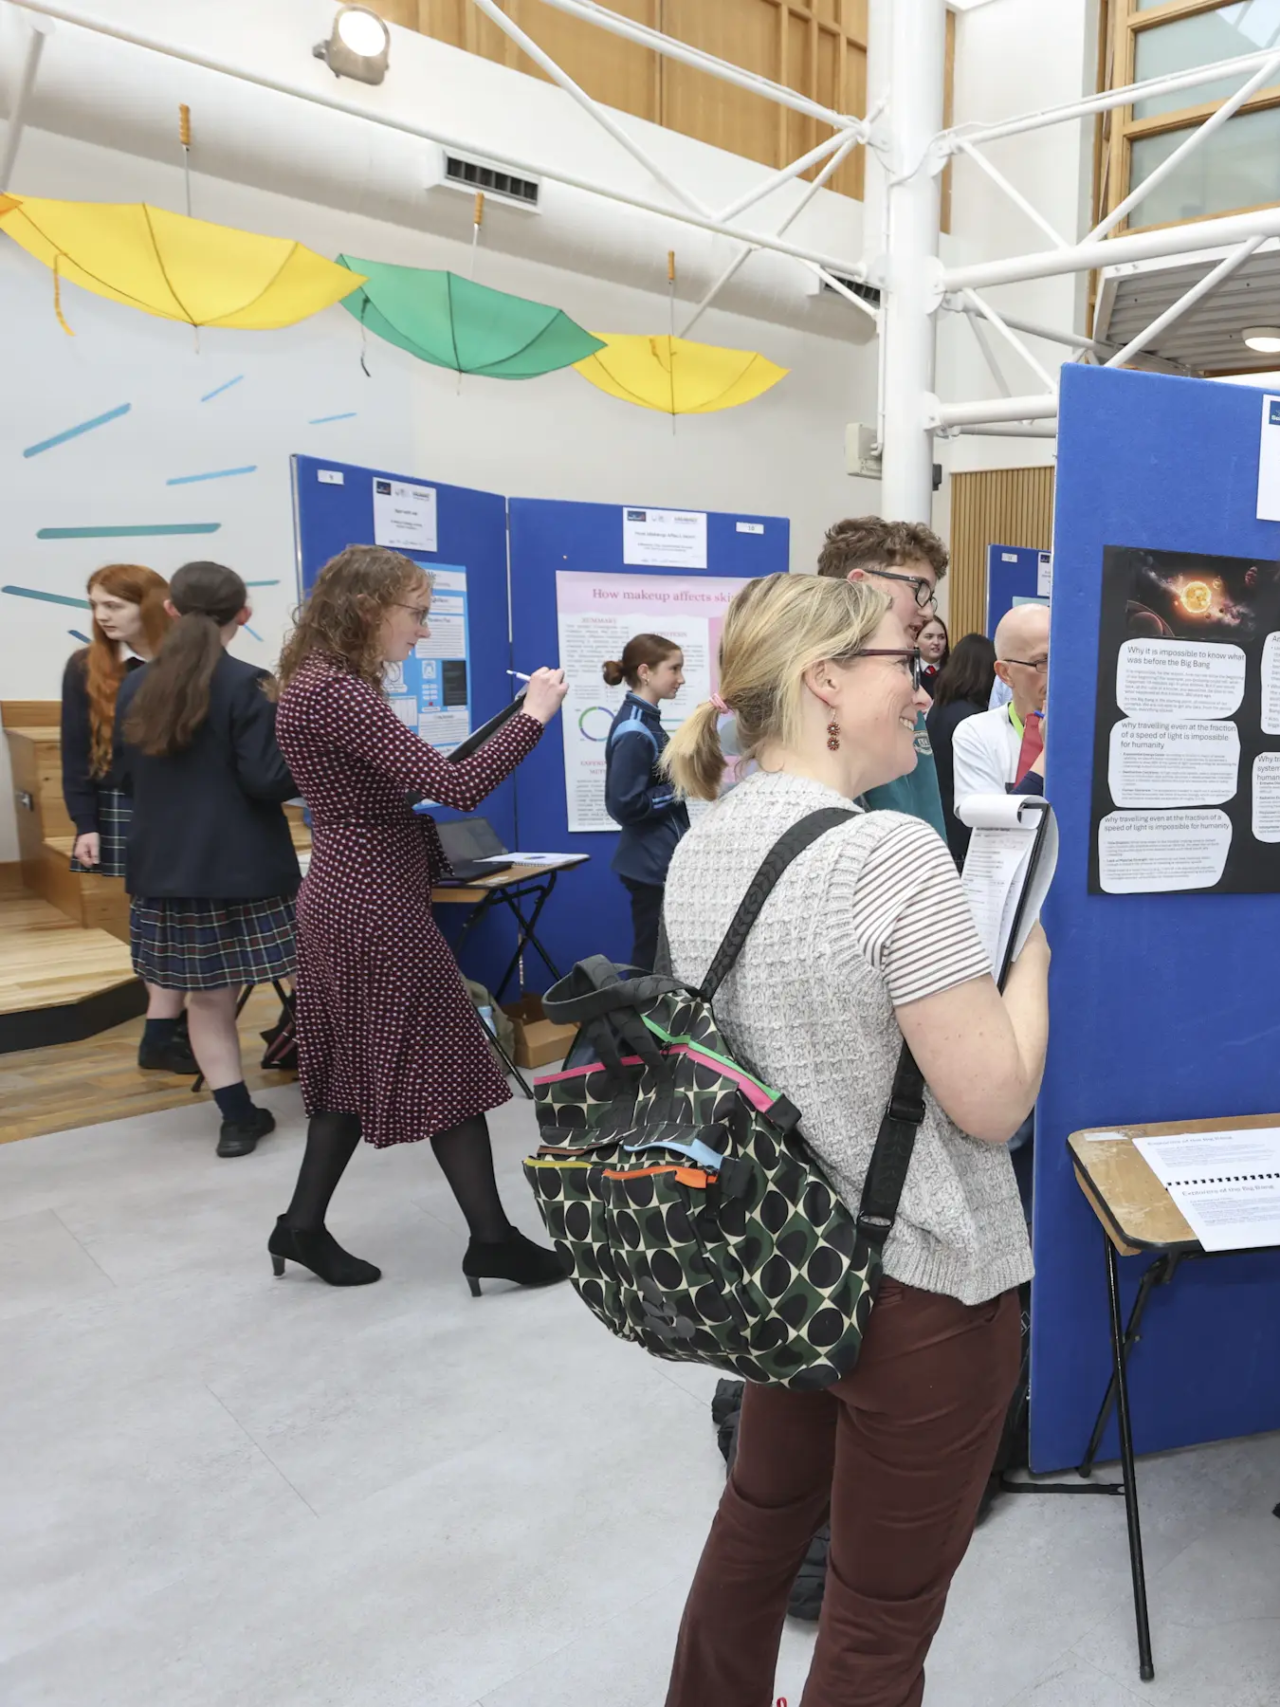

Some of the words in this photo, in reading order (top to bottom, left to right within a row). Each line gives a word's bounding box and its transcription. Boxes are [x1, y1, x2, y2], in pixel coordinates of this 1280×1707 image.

[593, 589, 619, 599] How
[623, 590, 670, 602] makeup
[673, 591, 711, 602] affects
[1128, 646, 1144, 655] Why
[1160, 649, 1197, 658] impossible
[1208, 651, 1226, 659] know
[1228, 652, 1244, 660] what
[1143, 658, 1166, 666] before
[1181, 660, 1191, 668] Big
[1193, 660, 1210, 669] Bang
[1121, 722, 1135, 730] why
[1138, 722, 1169, 731] travelling
[1197, 723, 1208, 731] the
[1168, 733, 1182, 741] light
[1191, 733, 1229, 742] impossible
[1131, 741, 1164, 749] humanity
[1120, 815, 1148, 823] travelling
[1133, 824, 1147, 832] light
